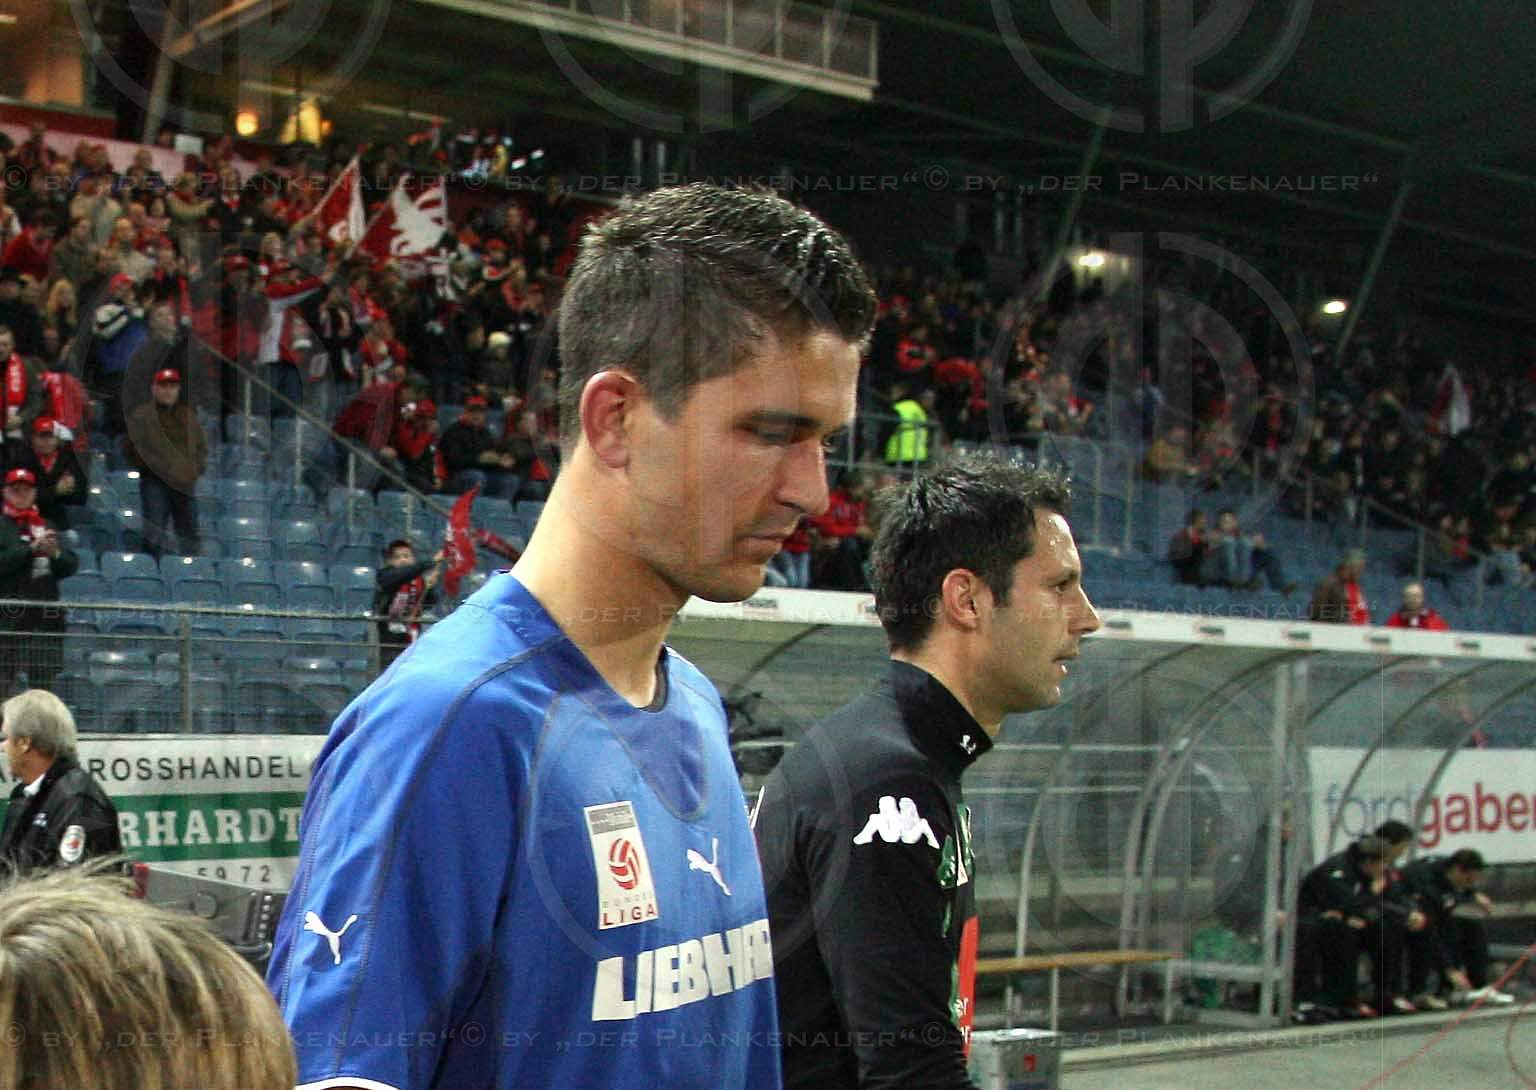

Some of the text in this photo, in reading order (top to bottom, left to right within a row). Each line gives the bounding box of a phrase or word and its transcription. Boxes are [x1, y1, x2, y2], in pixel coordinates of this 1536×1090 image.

[89, 755, 302, 781] ROSSHANDEL
[120, 808, 302, 847] RHARDT
[603, 904, 656, 926] LIGA
